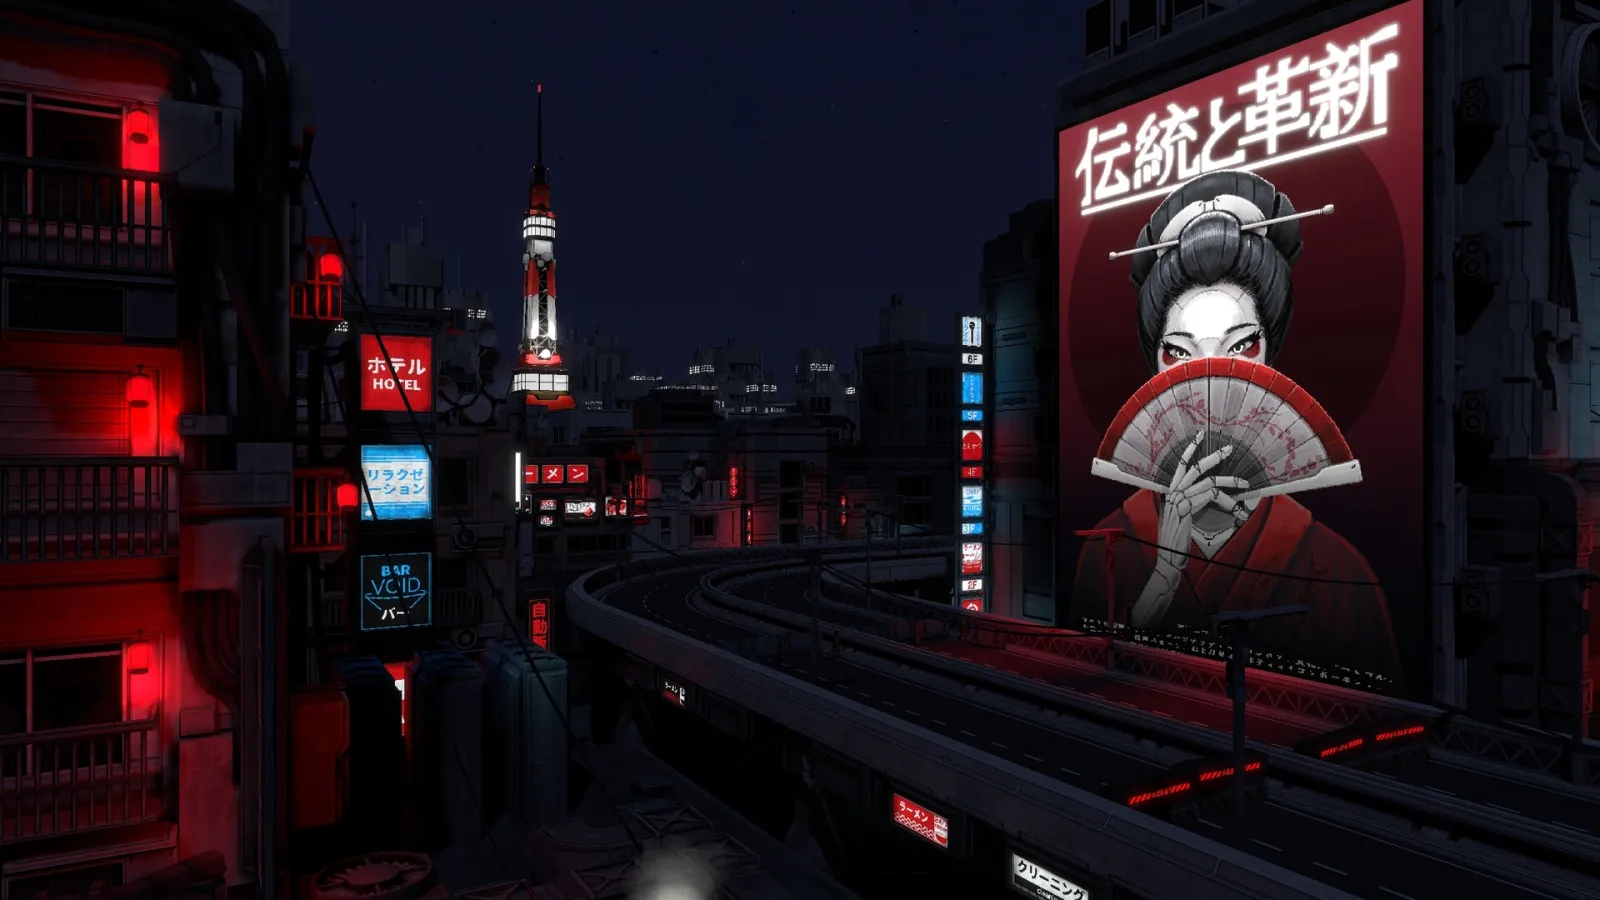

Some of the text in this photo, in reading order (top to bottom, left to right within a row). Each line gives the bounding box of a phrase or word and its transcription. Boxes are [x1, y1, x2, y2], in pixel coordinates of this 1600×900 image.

[1075, 23, 1399, 207] 伝統と革新
[367, 356, 427, 375] ホテル
[967, 354, 978, 364] 6F
[967, 411, 978, 420] 5F
[368, 468, 424, 481] リラクゼ
[367, 483, 425, 495] ーション
[381, 564, 411, 577] BAR
[967, 580, 977, 590] 2F
[381, 606, 410, 620] バー
[899, 801, 929, 823] ラーメン
[1017, 859, 1086, 900] クリーニング
